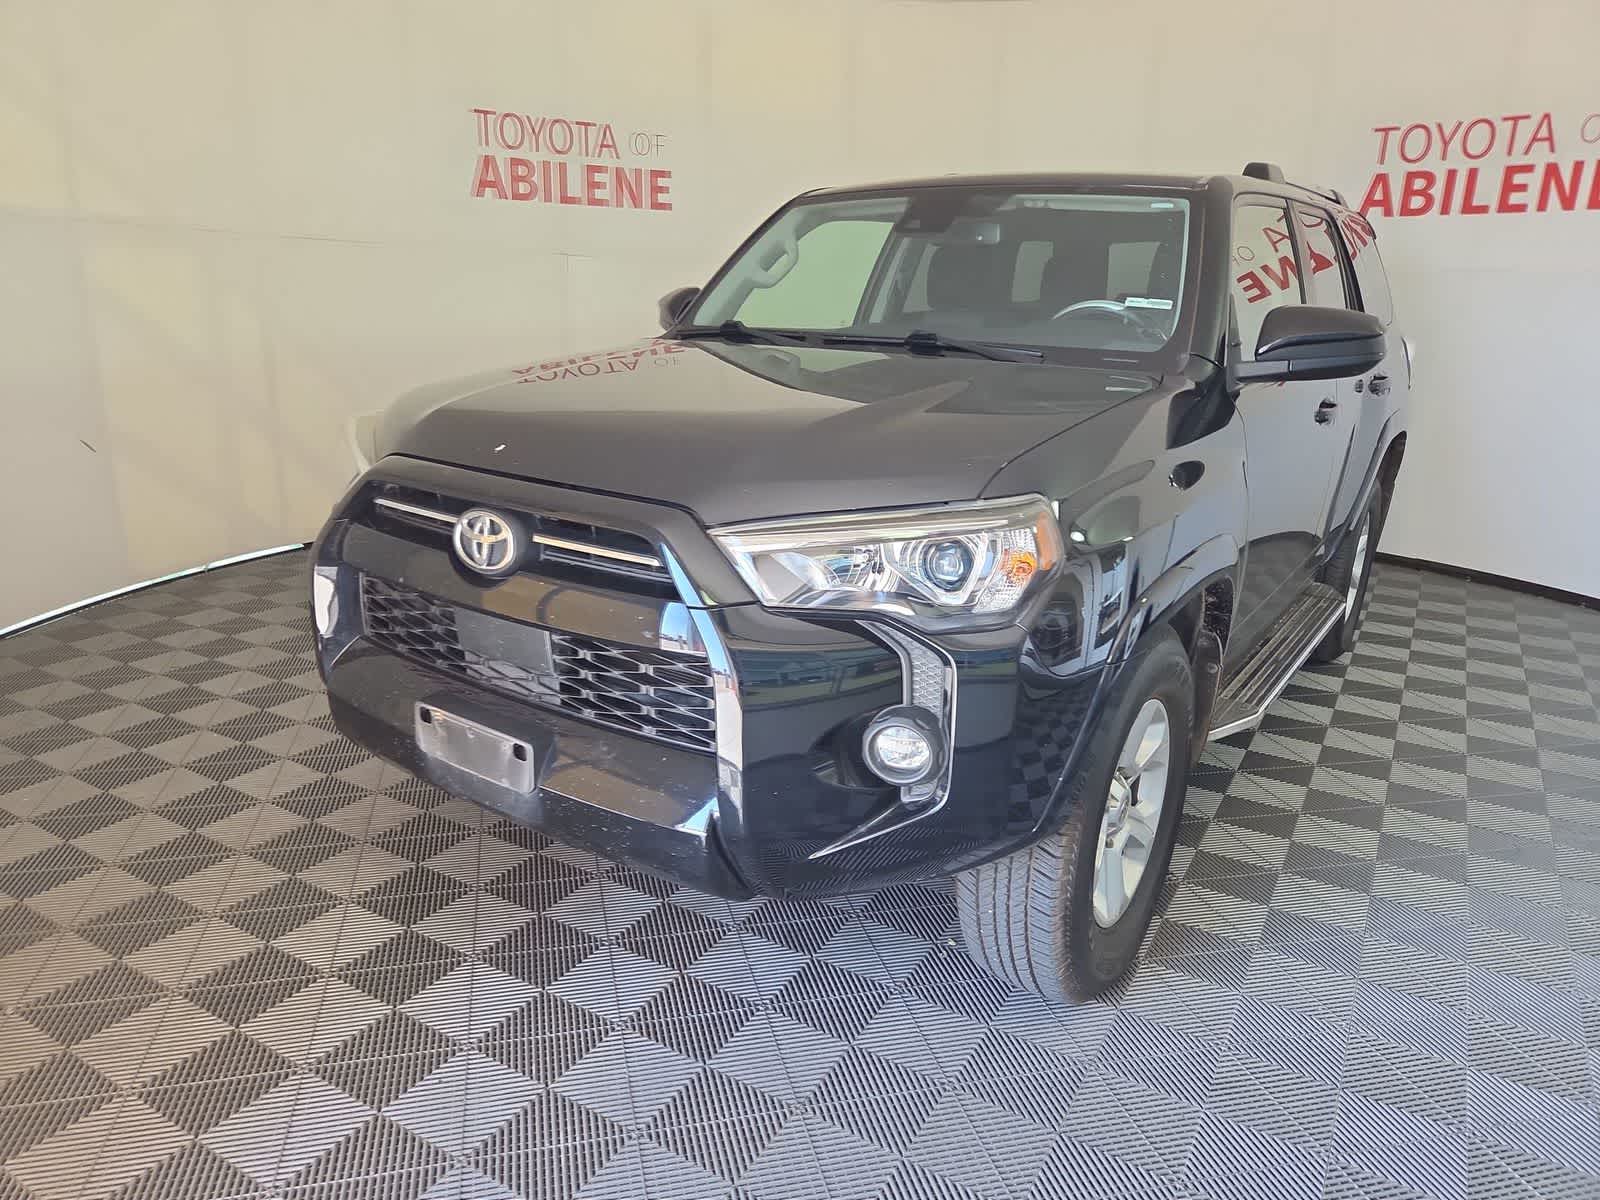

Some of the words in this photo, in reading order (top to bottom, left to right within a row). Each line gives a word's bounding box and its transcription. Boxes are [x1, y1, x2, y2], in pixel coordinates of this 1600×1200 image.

[470, 108, 620, 160] TOYOTA
[630, 132, 667, 157] OF
[1373, 113, 1556, 165] TOYOTA
[471, 154, 673, 211] ABILENE
